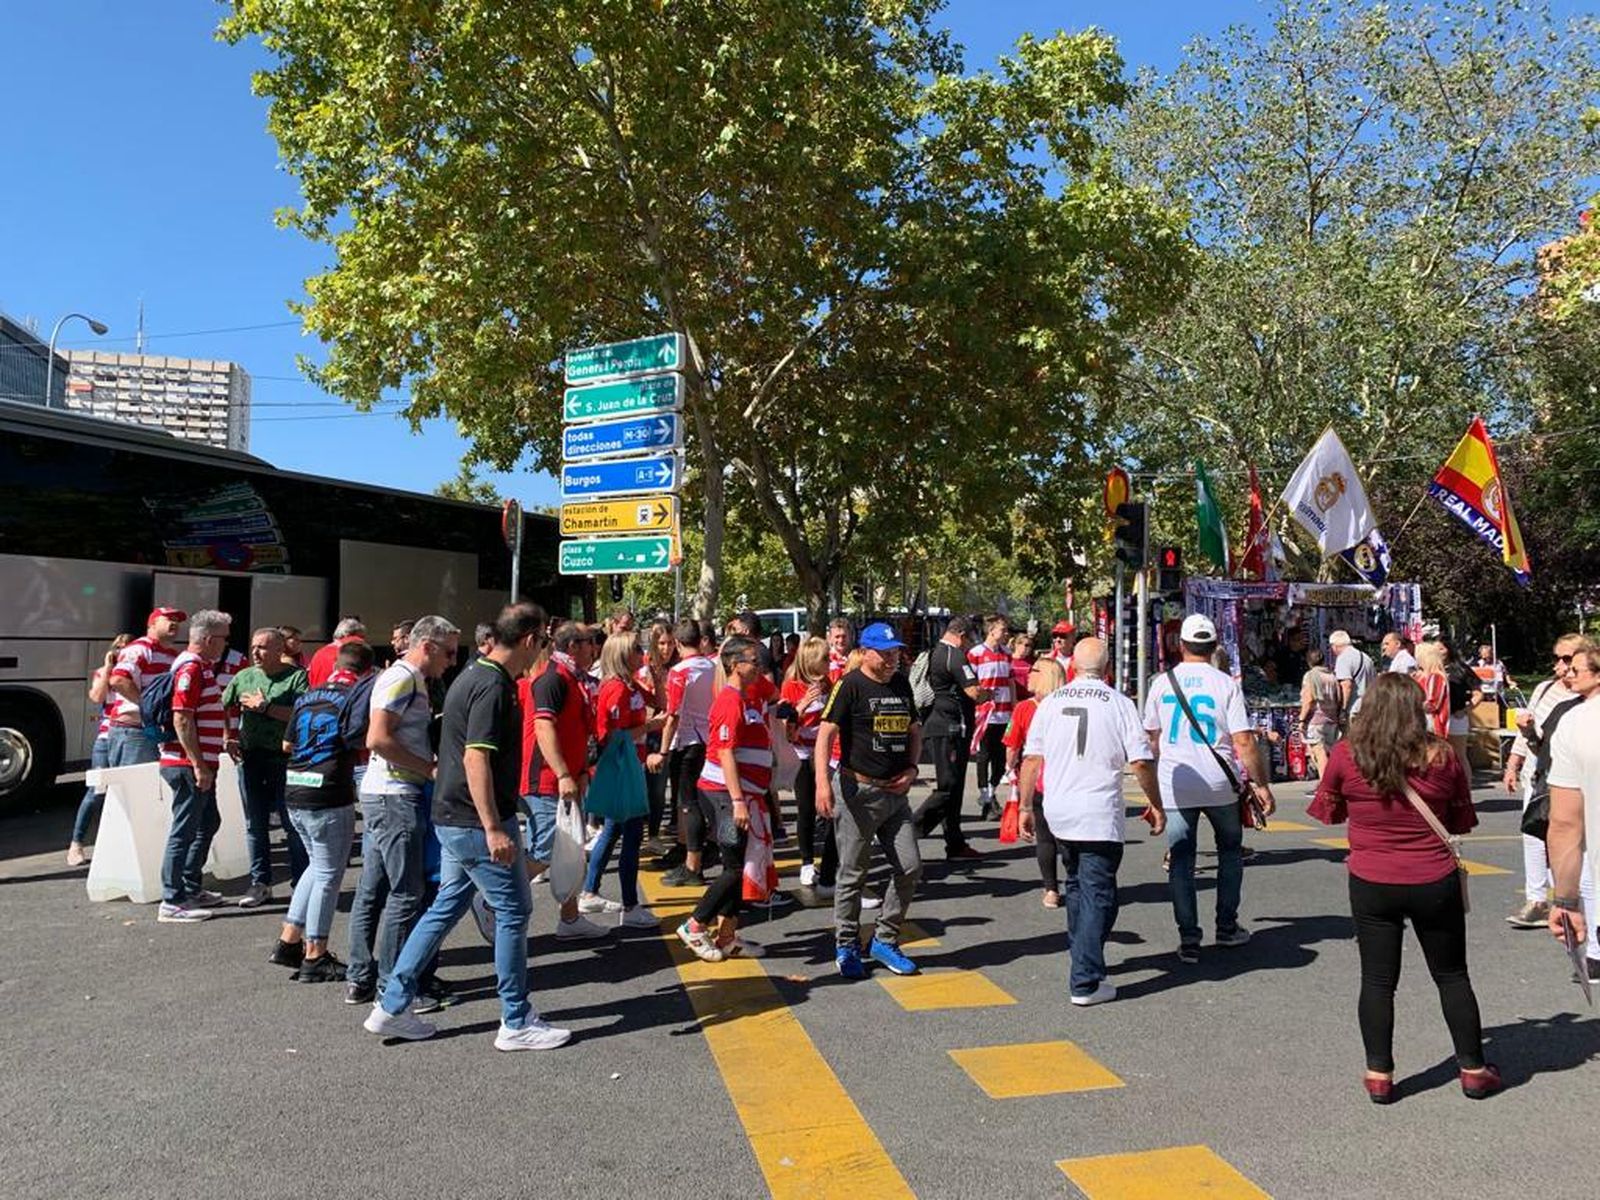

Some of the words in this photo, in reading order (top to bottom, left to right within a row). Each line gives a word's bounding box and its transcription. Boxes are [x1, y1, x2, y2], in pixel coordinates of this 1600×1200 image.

[568, 362, 609, 377] General
[597, 399, 622, 412] Juan
[622, 396, 636, 408] de
[649, 393, 674, 405] Cruz
[567, 432, 594, 443] todas
[567, 441, 622, 455] direcciones
[565, 475, 601, 488] Burgos
[598, 504, 609, 513] de
[1434, 487, 1473, 525] REAL
[1472, 515, 1504, 549] MAD
[562, 556, 594, 567] Cuzco
[1161, 694, 1217, 745] 76
[1061, 706, 1089, 759] 7
